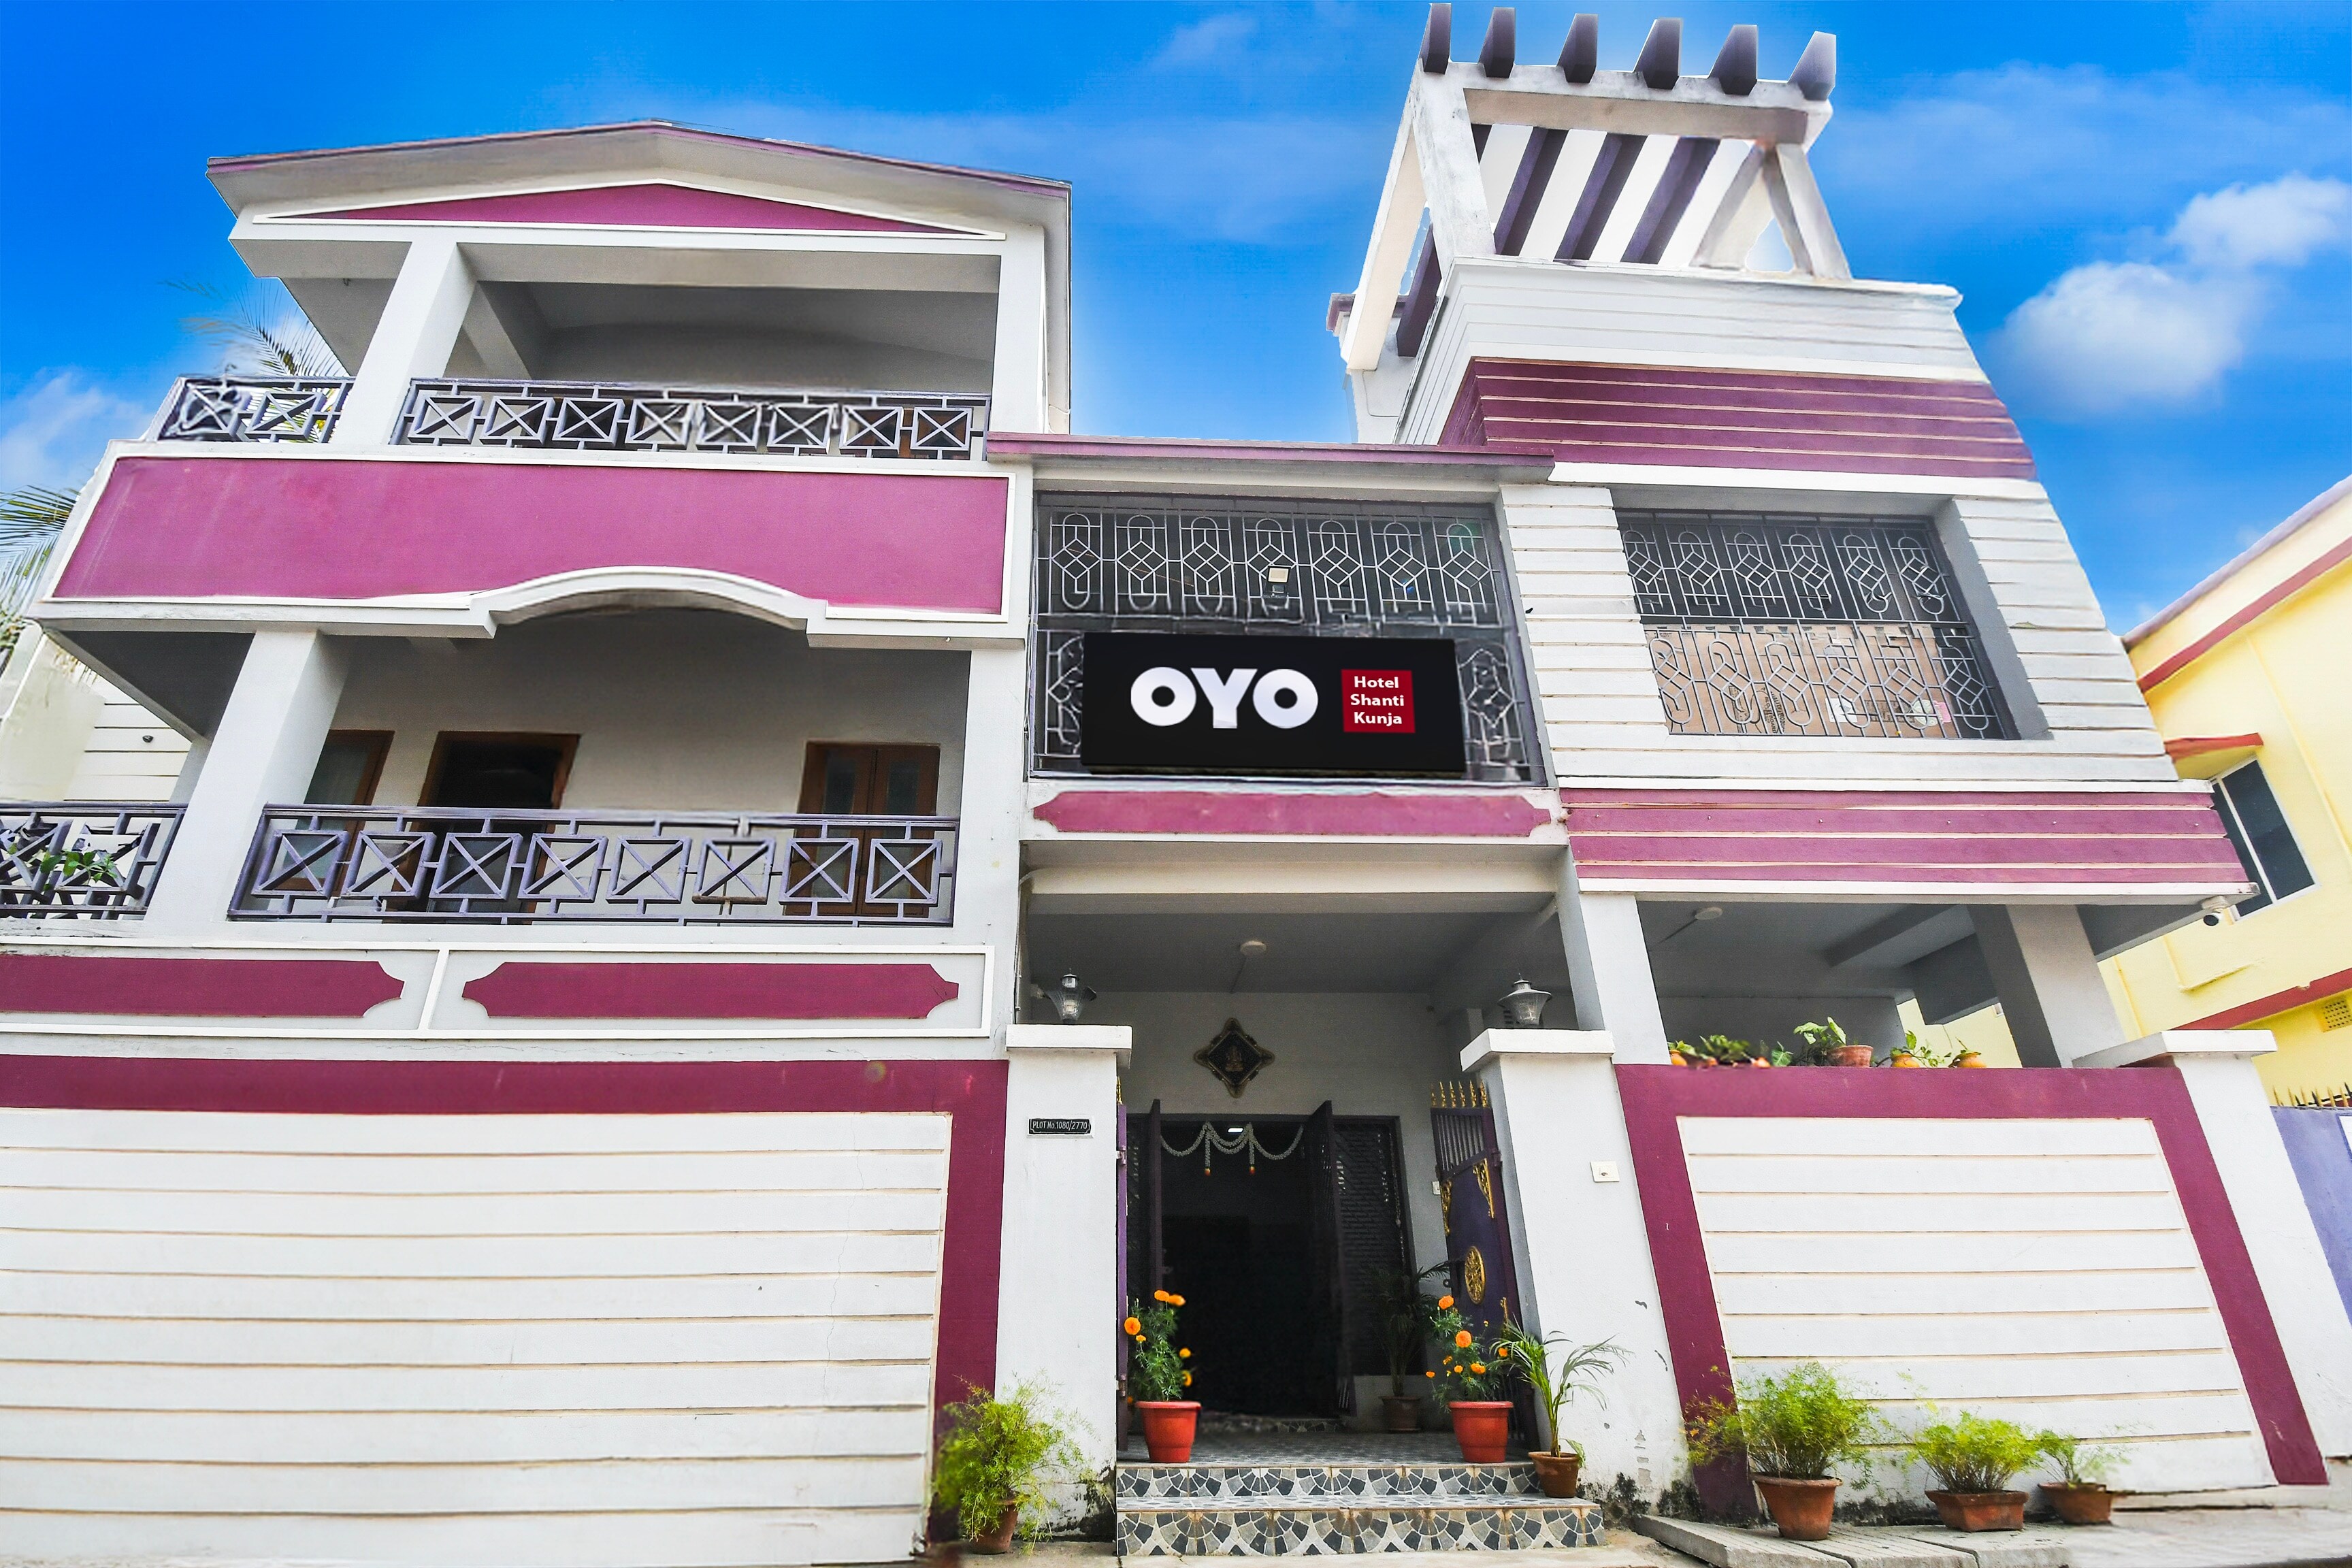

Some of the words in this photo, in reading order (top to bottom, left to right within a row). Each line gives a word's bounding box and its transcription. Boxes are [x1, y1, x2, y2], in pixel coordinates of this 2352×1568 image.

[1354, 676, 1399, 689] Hotel
[1130, 666, 1319, 729] OYO
[1350, 693, 1405, 706] Shanti
[1354, 711, 1403, 727] Kunja
[1032, 1120, 1047, 1129] PLOT
